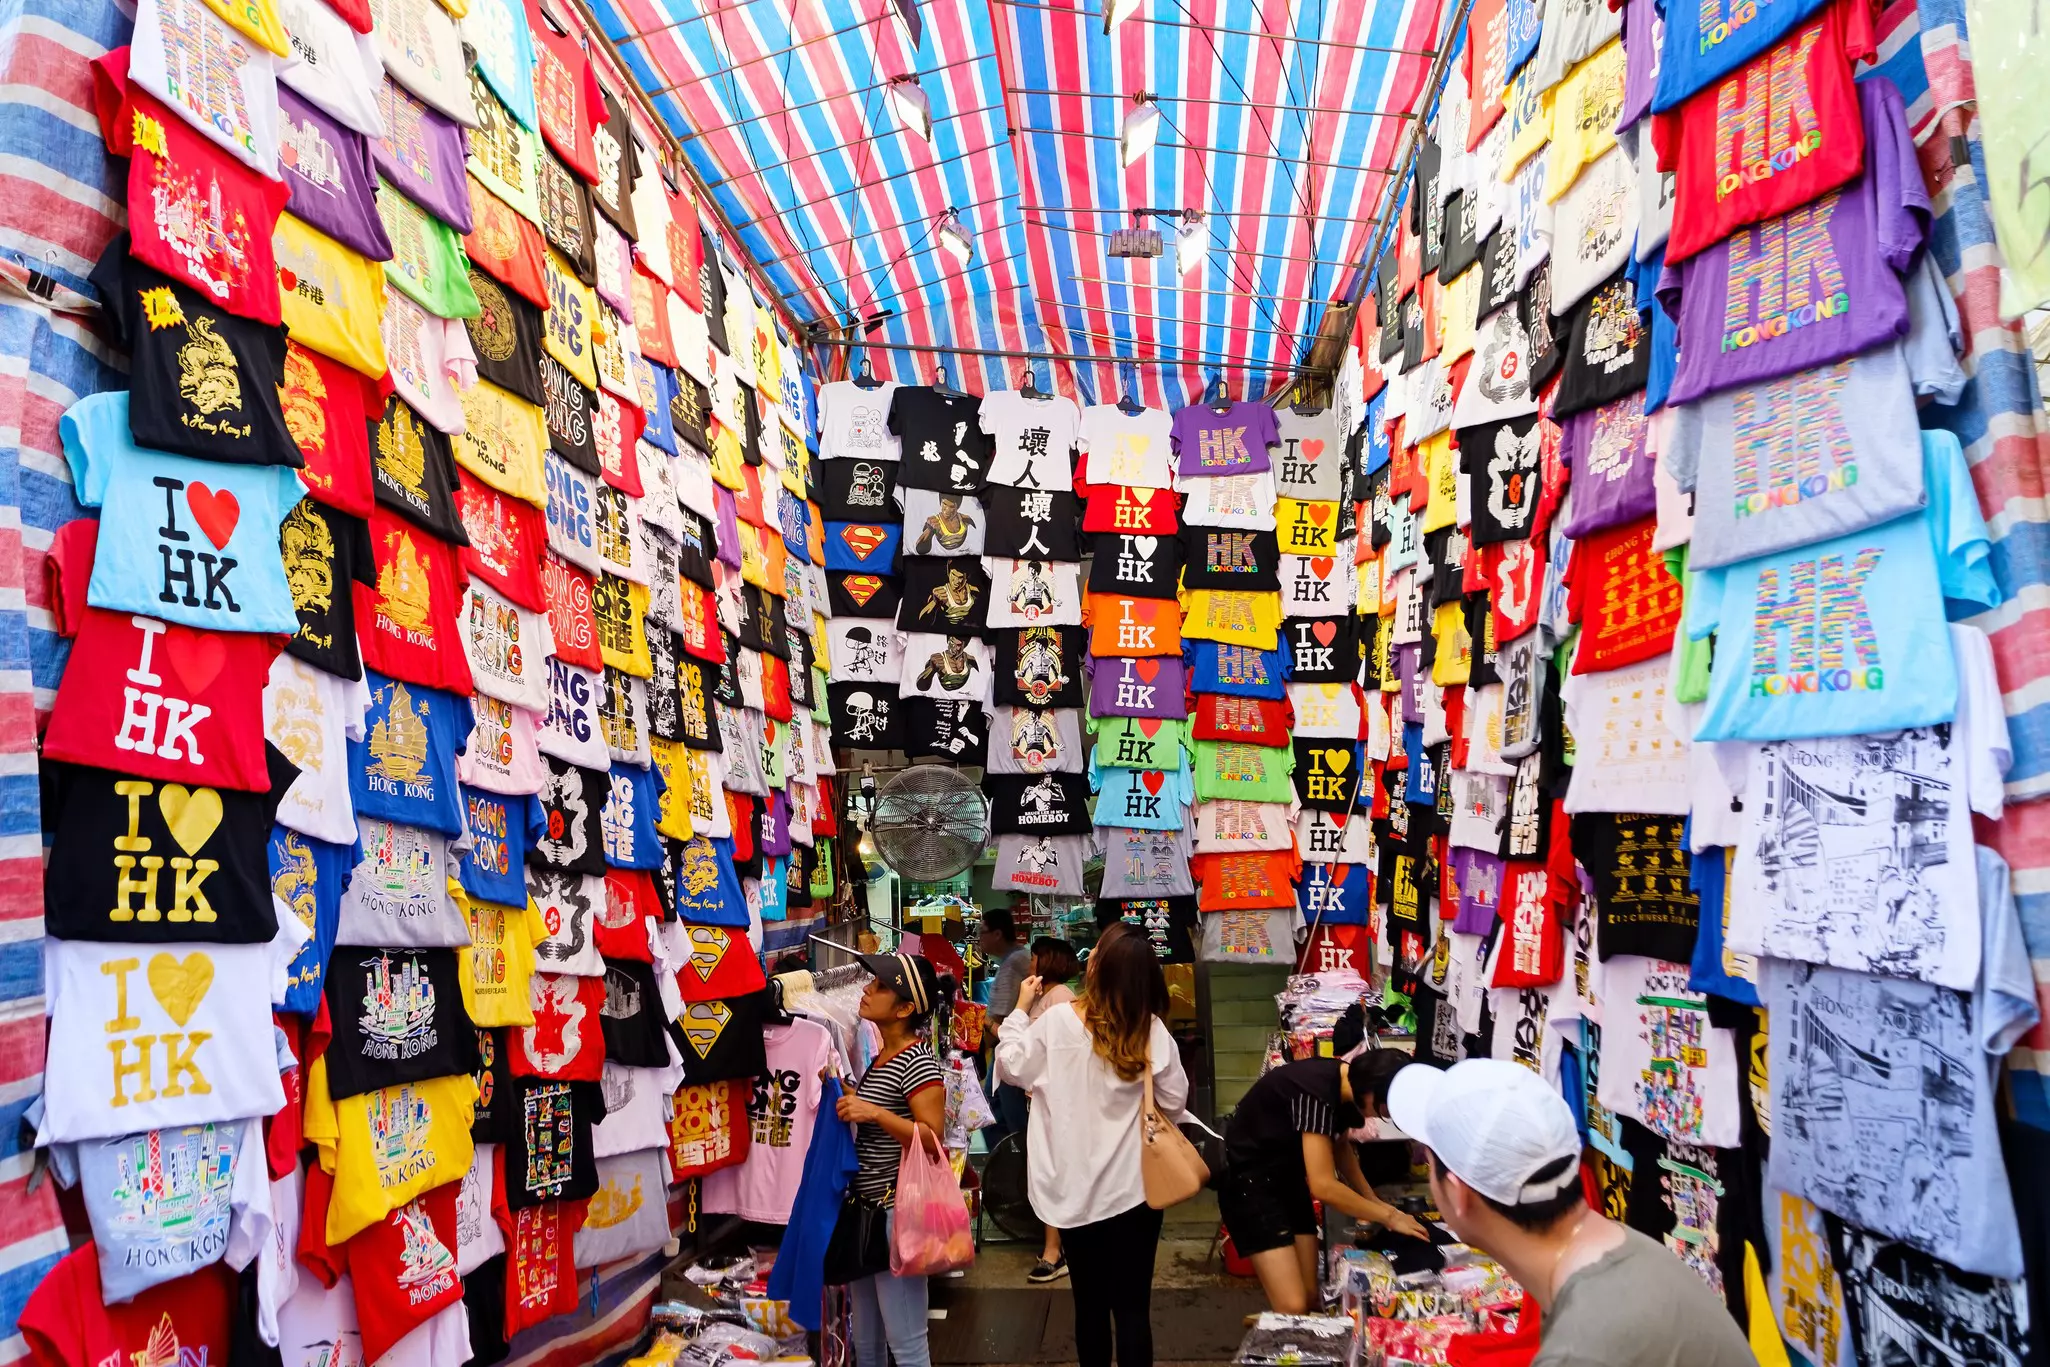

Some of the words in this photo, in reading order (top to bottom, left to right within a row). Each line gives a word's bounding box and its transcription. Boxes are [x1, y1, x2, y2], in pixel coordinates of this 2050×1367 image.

[291, 35, 317, 65] 香港
[1716, 129, 1822, 203] HONGKONG
[296, 278, 324, 305] 香港
[1720, 292, 1849, 354] HONGKONG
[1586, 344, 1618, 367] HONG
[1604, 348, 1635, 375] KONG
[539, 357, 583, 411] ONG
[544, 396, 587, 447] ONG
[463, 431, 488, 452] ONG
[1284, 438, 1299, 461] I
[477, 450, 507, 475] KONG
[1013, 426, 1051, 487] 壞人
[1200, 456, 1252, 467] HONGKONG
[545, 458, 590, 514] ONG
[1281, 462, 1316, 485] HK
[377, 466, 403, 497] HONG
[405, 490, 431, 517] KONG
[1116, 486, 1130, 505] I
[1734, 463, 1859, 520] HONGKONG
[152, 476, 190, 542] I
[546, 493, 592, 548] ONG
[1114, 506, 1152, 529] HK
[1294, 502, 1309, 524] I
[1018, 490, 1054, 556] 壞人
[1119, 534, 1133, 559] I
[1290, 526, 1328, 548] HK
[158, 544, 242, 613] HK
[1116, 559, 1154, 583] HK
[1206, 564, 1259, 574] HONGKONG
[1296, 556, 1311, 579] I
[542, 560, 589, 613] ONG
[1293, 581, 1331, 602] HK
[470, 588, 520, 643] HONG
[592, 586, 632, 622] ONG
[1119, 600, 1134, 625] I
[1752, 548, 1885, 676] HK
[375, 613, 402, 639] HONG
[407, 629, 437, 651] KONG
[546, 598, 591, 650] ONG
[1295, 623, 1311, 647] I
[470, 624, 523, 676] KONG
[1117, 626, 1156, 649] HK
[126, 615, 167, 687] I
[1295, 648, 1334, 671] HK
[544, 656, 590, 706] ONG
[1120, 658, 1136, 684] I
[1218, 675, 1270, 686] HONGKONG
[1750, 667, 1885, 698] HONGKONG
[1025, 693, 1053, 705] RESPECT
[1116, 684, 1156, 709] HK
[114, 686, 212, 765] HK
[544, 697, 592, 743] ONG
[1120, 717, 1136, 738] I
[1215, 723, 1265, 733] HONGKONG
[1117, 739, 1153, 764] HK
[1308, 749, 1324, 775] I
[1791, 749, 1833, 768] HONG
[368, 776, 398, 796] HONG
[404, 782, 435, 801] KONG
[1128, 769, 1142, 794] I
[1215, 771, 1268, 783] HONGKONG
[1306, 775, 1346, 801] HK
[113, 780, 154, 852] I
[468, 794, 507, 839] HONG
[600, 798, 635, 828] ONG
[1018, 813, 1070, 825] HOMEBOY
[1124, 795, 1161, 819] HK
[1310, 810, 1326, 827] I
[1215, 832, 1268, 840] HONGKONG
[1309, 828, 1348, 853] HK
[470, 832, 509, 876] KONG
[1011, 873, 1059, 888] HOMEBOY
[1310, 862, 1325, 886] I
[109, 855, 220, 922] HK
[1307, 887, 1346, 912] HK
[361, 892, 393, 917] HONG
[399, 899, 437, 918] KONG
[1121, 901, 1169, 909] HONGKONG
[470, 907, 505, 945] HONG
[1320, 924, 1334, 947] I
[1221, 946, 1274, 956] HONGKONG
[1319, 947, 1355, 973] HK
[472, 947, 505, 984] KONG
[100, 957, 141, 1033] I
[1814, 995, 1855, 1020] HONG
[1881, 1011, 1932, 1036] KONG
[361, 1039, 399, 1060] HONG
[400, 1031, 438, 1060] KONG
[106, 1030, 214, 1108] HK
[750, 1069, 801, 1093] ONG
[673, 1081, 730, 1112] HONG
[749, 1093, 797, 1117] ONG
[672, 1103, 730, 1139] KONG
[397, 1151, 437, 1184] KONG
[124, 1246, 184, 1268] HONG
[190, 1228, 230, 1264] KON
[410, 1274, 453, 1306] HONG
